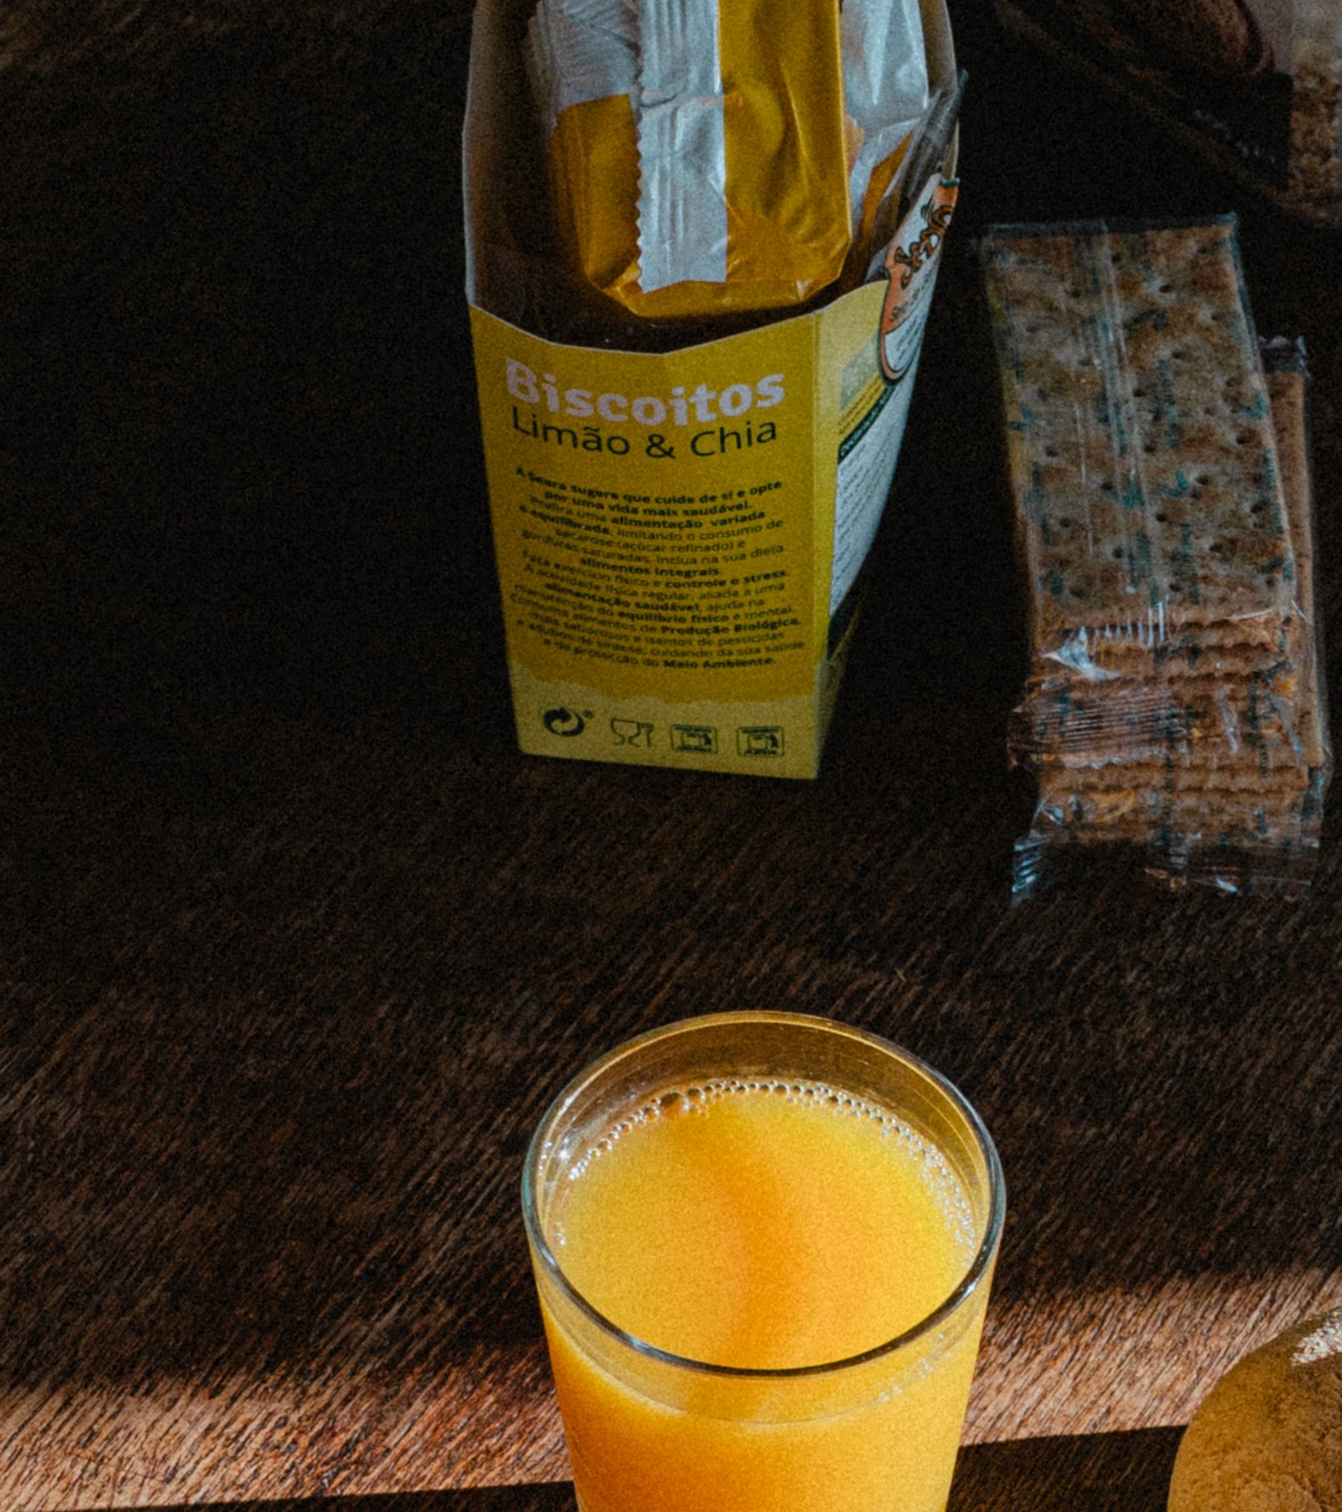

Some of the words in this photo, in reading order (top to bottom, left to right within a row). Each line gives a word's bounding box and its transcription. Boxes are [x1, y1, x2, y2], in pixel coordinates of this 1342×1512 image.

[506, 358, 785, 426] Biscoitos
[511, 406, 630, 456] Limão
[645, 432, 676, 458] &
[690, 420, 777, 458] Chia
[570, 485, 618, 499] sugere
[623, 493, 650, 504] que
[654, 494, 695, 504] cuide
[750, 481, 781, 496] opte
[544, 491, 567, 503] por
[572, 497, 604, 510] uma
[608, 502, 638, 514] vida
[643, 507, 679, 517] mais
[577, 511, 607, 522] uma
[611, 516, 703, 530] alimentação
[711, 511, 766, 526] variada
[617, 528, 683, 541] limitando
[699, 525, 763, 540] consumo
[670, 541, 734, 554] refinado)
[722, 553, 747, 563] sua
[750, 544, 784, 558] dieta
[580, 558, 651, 575] alimentos
[665, 578, 727, 589] controle
[544, 583, 631, 608] alimentação
[707, 599, 745, 612] ajuda
[660, 625, 730, 636] Produção
[663, 659, 699, 669] Meio
